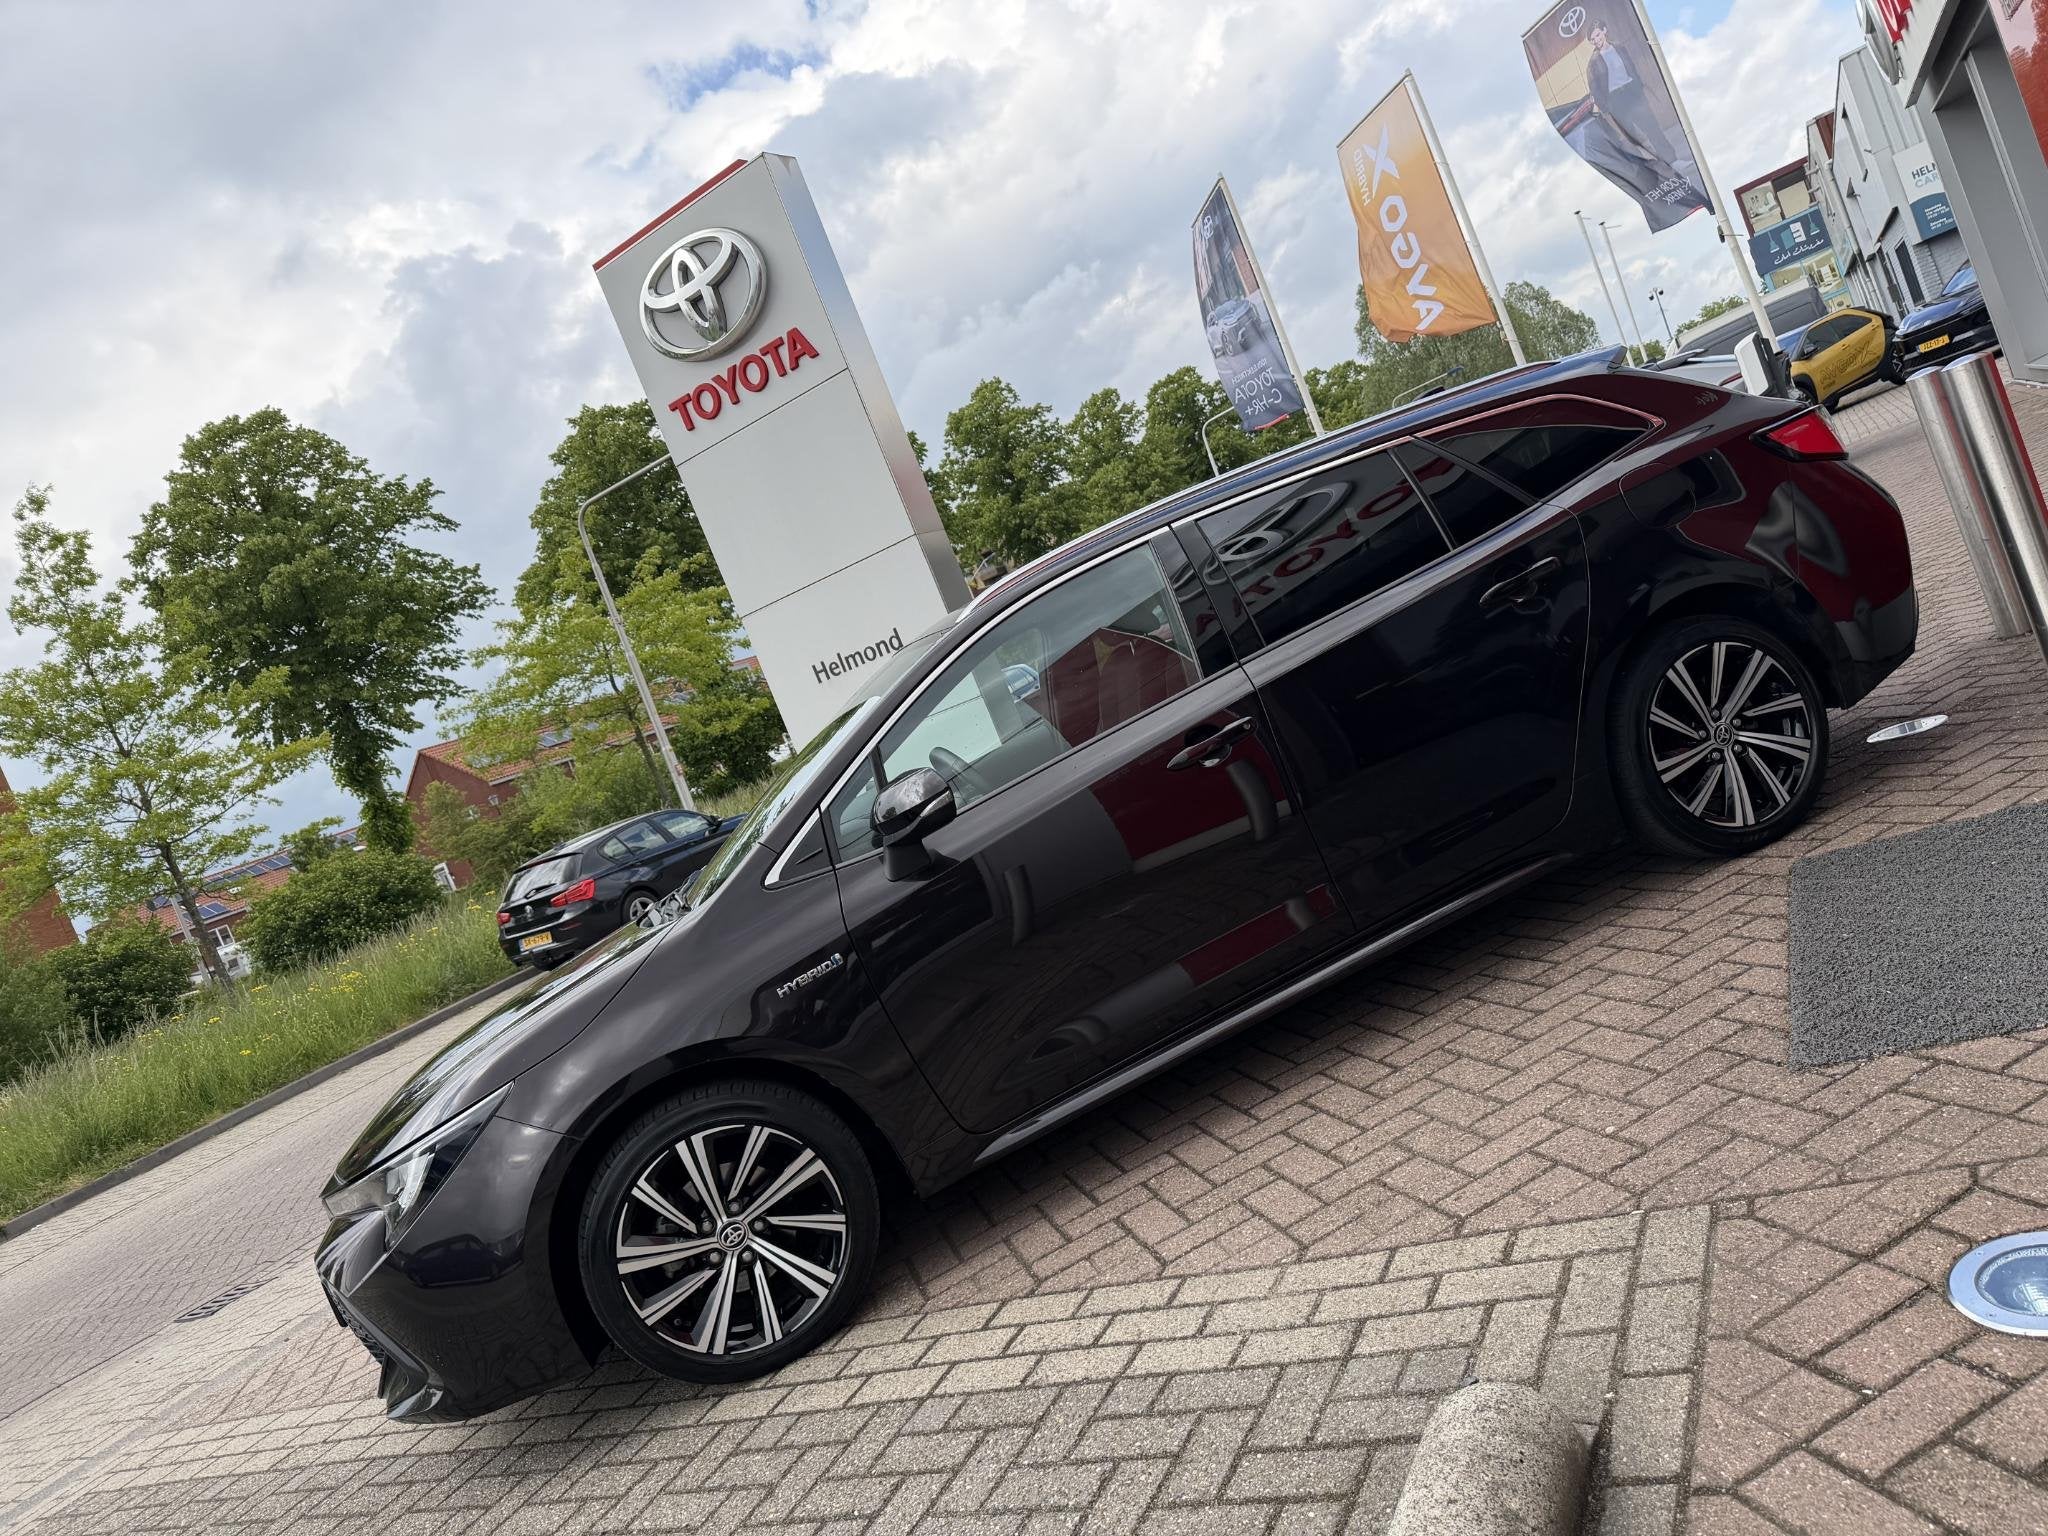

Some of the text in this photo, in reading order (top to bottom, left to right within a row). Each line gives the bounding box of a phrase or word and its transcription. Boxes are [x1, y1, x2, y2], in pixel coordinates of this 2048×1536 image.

[668, 326, 820, 431] TOYOTA
[811, 627, 904, 684] Helmond
[776, 960, 832, 998] HYBRID
